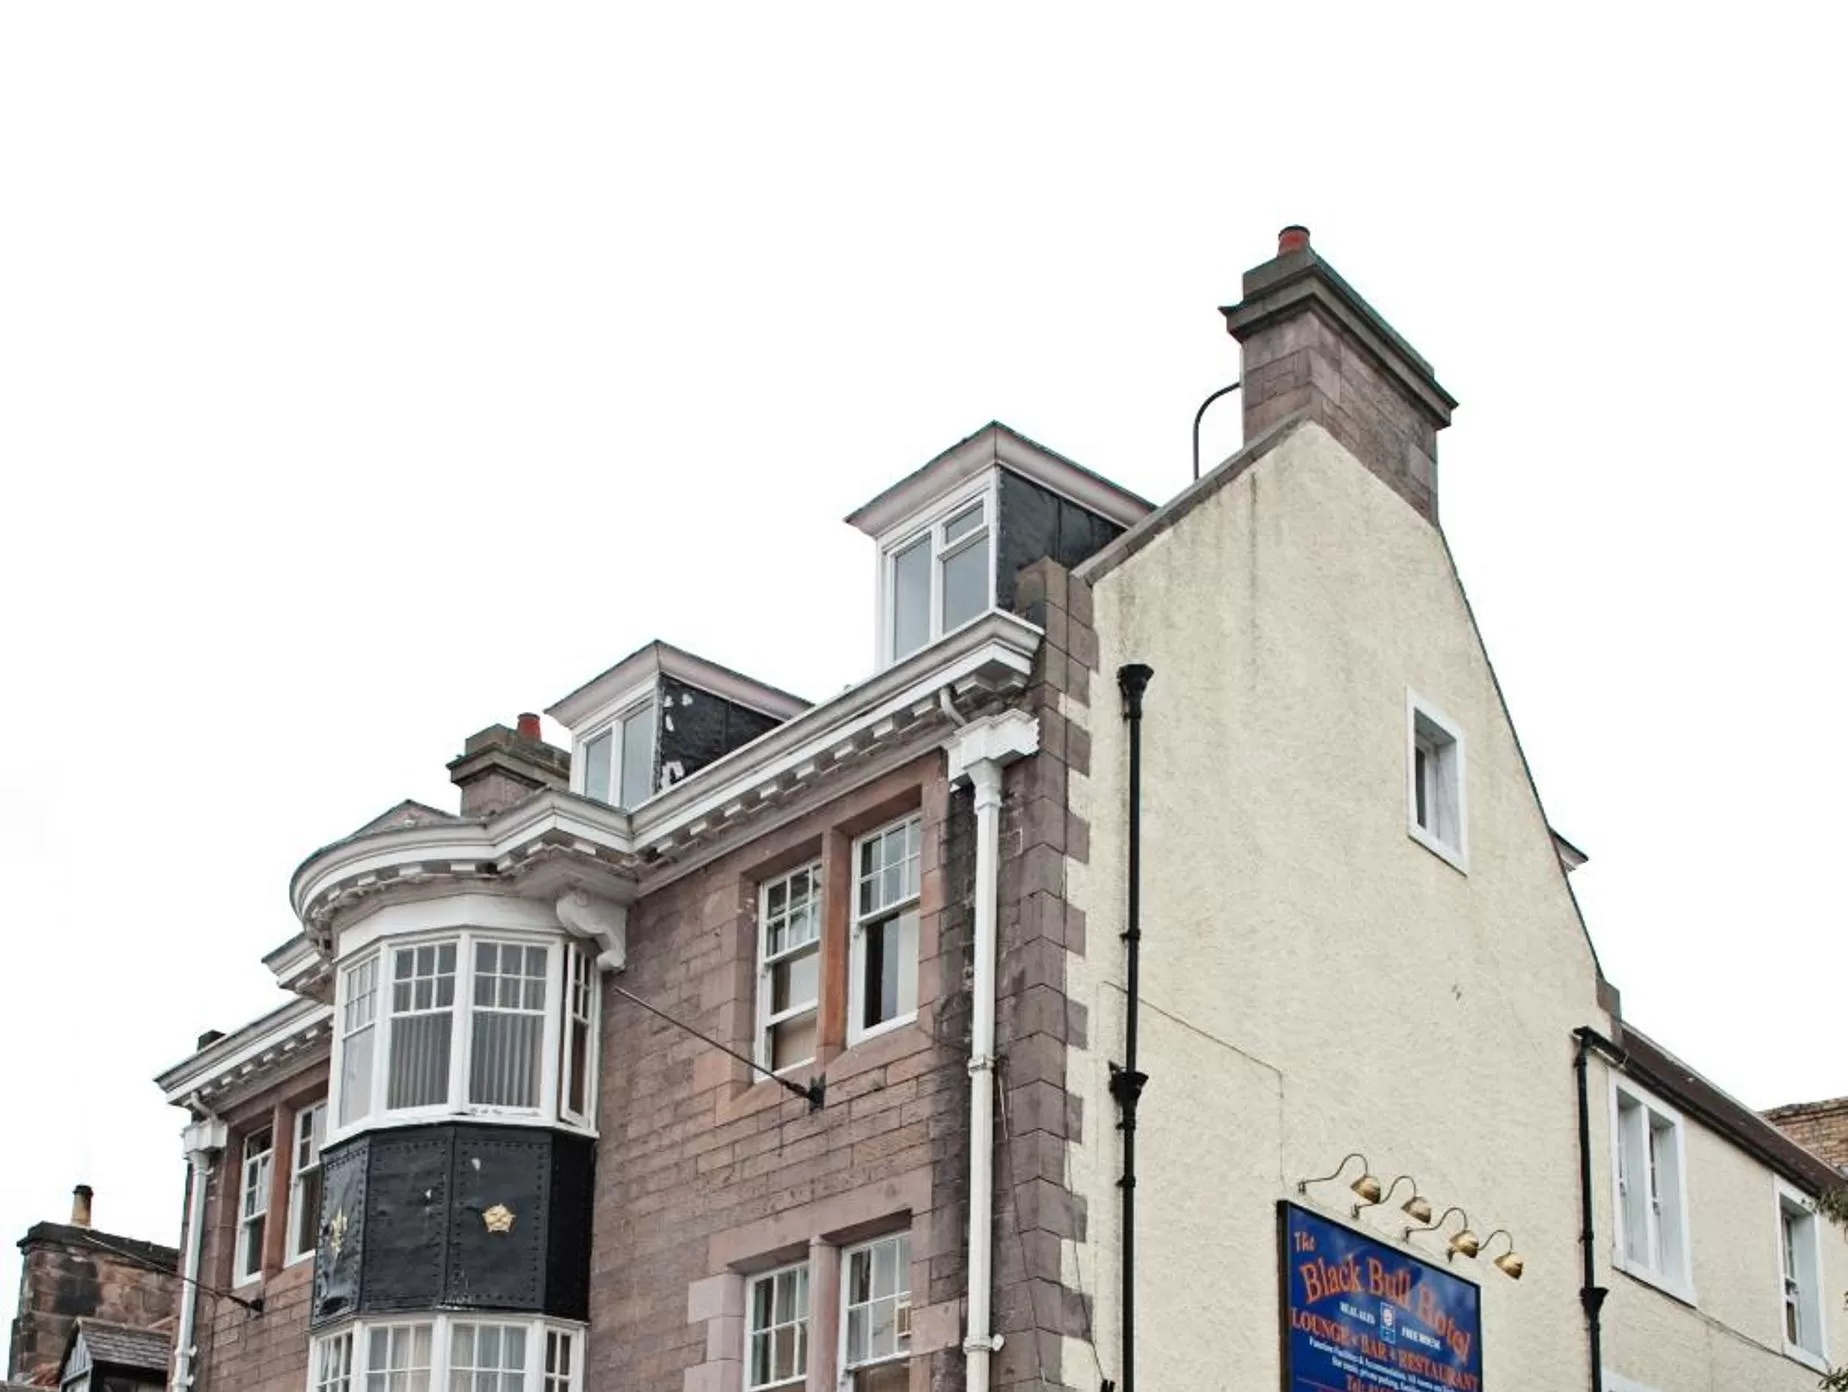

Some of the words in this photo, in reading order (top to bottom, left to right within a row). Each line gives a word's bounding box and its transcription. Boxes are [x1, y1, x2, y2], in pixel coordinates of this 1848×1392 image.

[1294, 1231, 1315, 1252] The
[1292, 1308, 1348, 1344] LOUNGE
[1362, 1335, 1385, 1360] BAR
[1399, 1350, 1478, 1392] RESTAURANT
[1301, 1255, 1361, 1303] Black
[1369, 1259, 1410, 1309] Bull
[1420, 1285, 1470, 1363] Hotel
